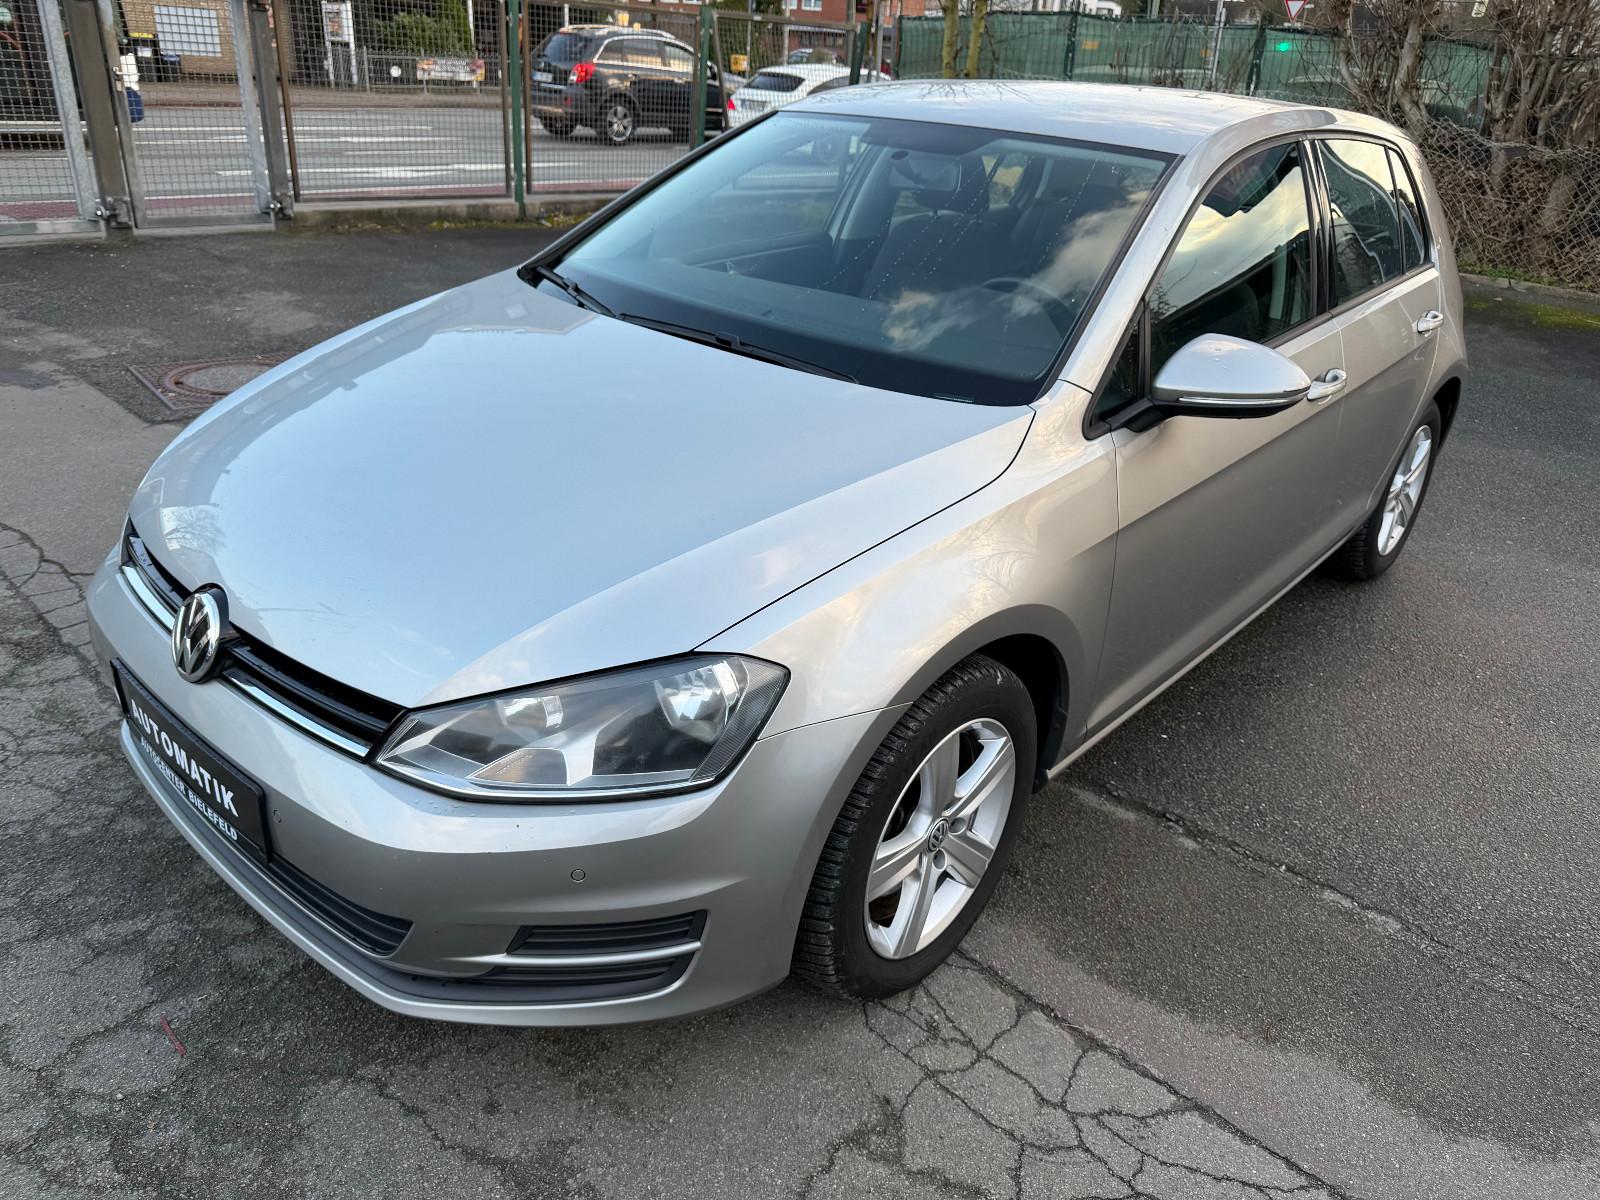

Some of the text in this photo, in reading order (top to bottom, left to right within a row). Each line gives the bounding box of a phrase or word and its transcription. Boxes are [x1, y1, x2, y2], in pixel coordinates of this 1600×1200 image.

[131, 699, 239, 817] AUTOMATIK
[140, 736, 239, 841] AUTOCENTER BIELEFELD
